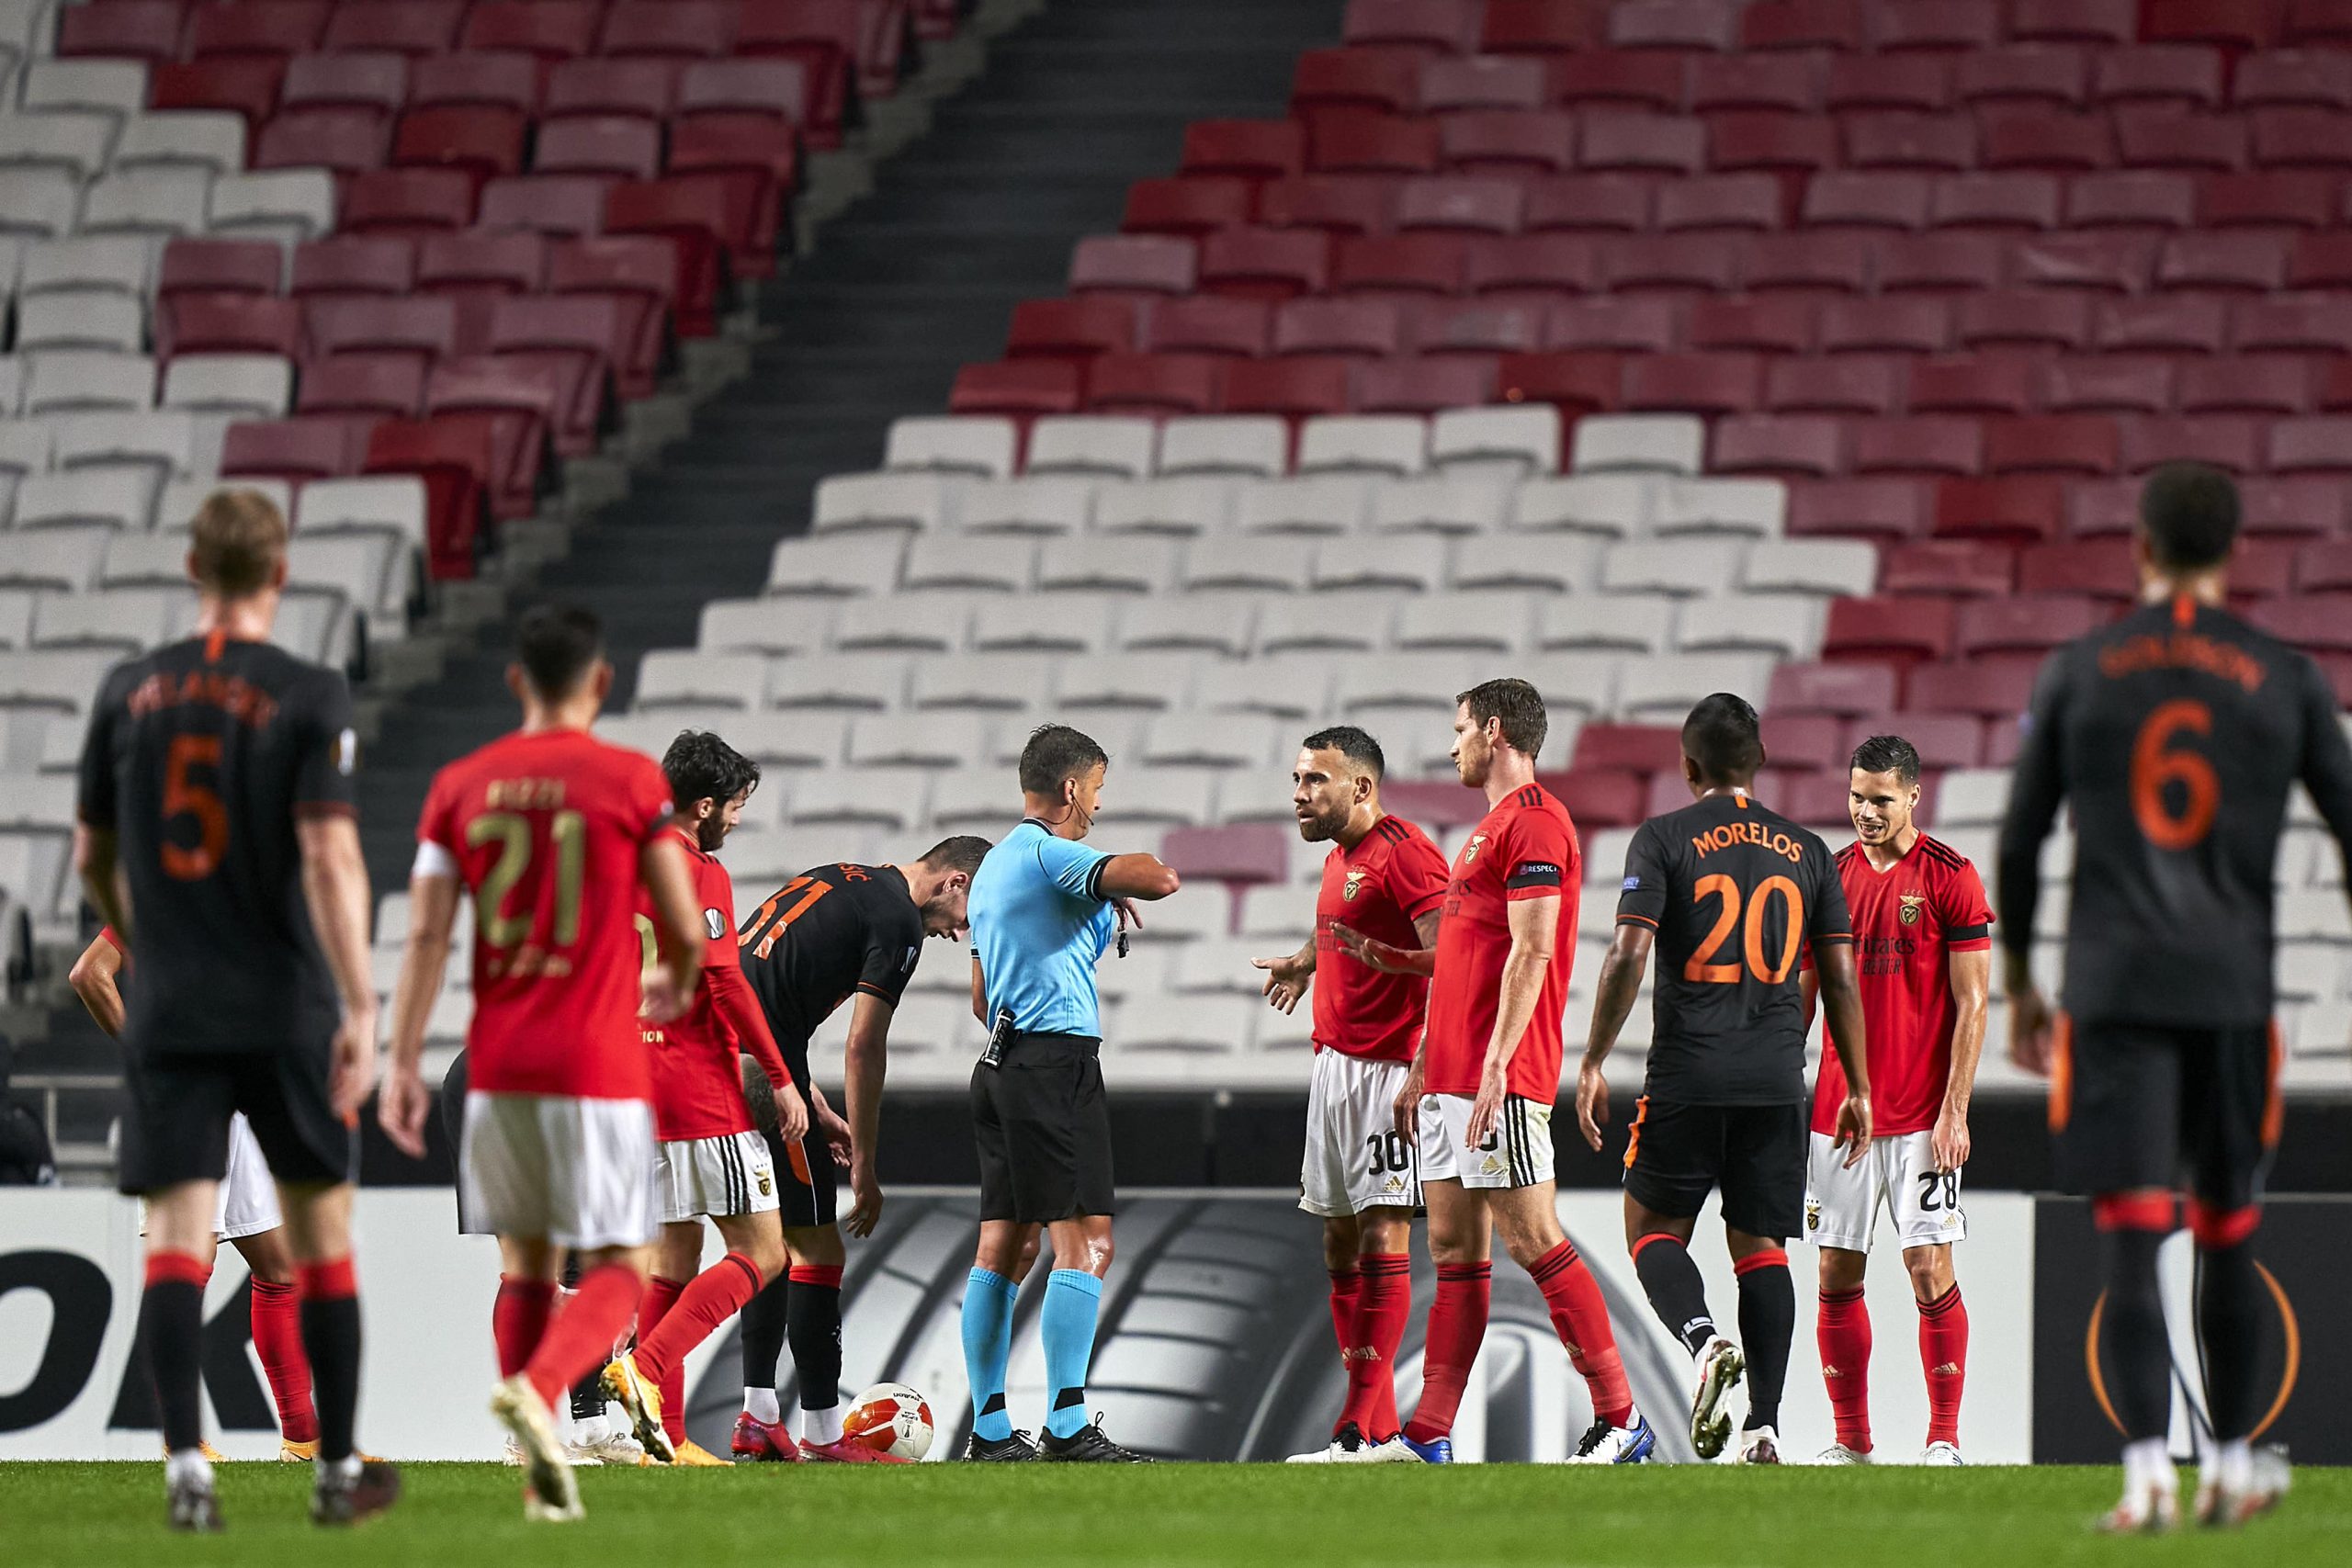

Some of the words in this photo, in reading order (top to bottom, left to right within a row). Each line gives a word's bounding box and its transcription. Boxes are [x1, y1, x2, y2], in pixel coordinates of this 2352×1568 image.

[161, 733, 229, 880] 5
[2129, 700, 2221, 851] 6
[466, 810, 586, 947] 21
[1691, 822, 1803, 863] MORELOS
[1684, 874, 1804, 985] 20
[1366, 1131, 1409, 1175] 30
[1917, 1171, 1957, 1212] 28
